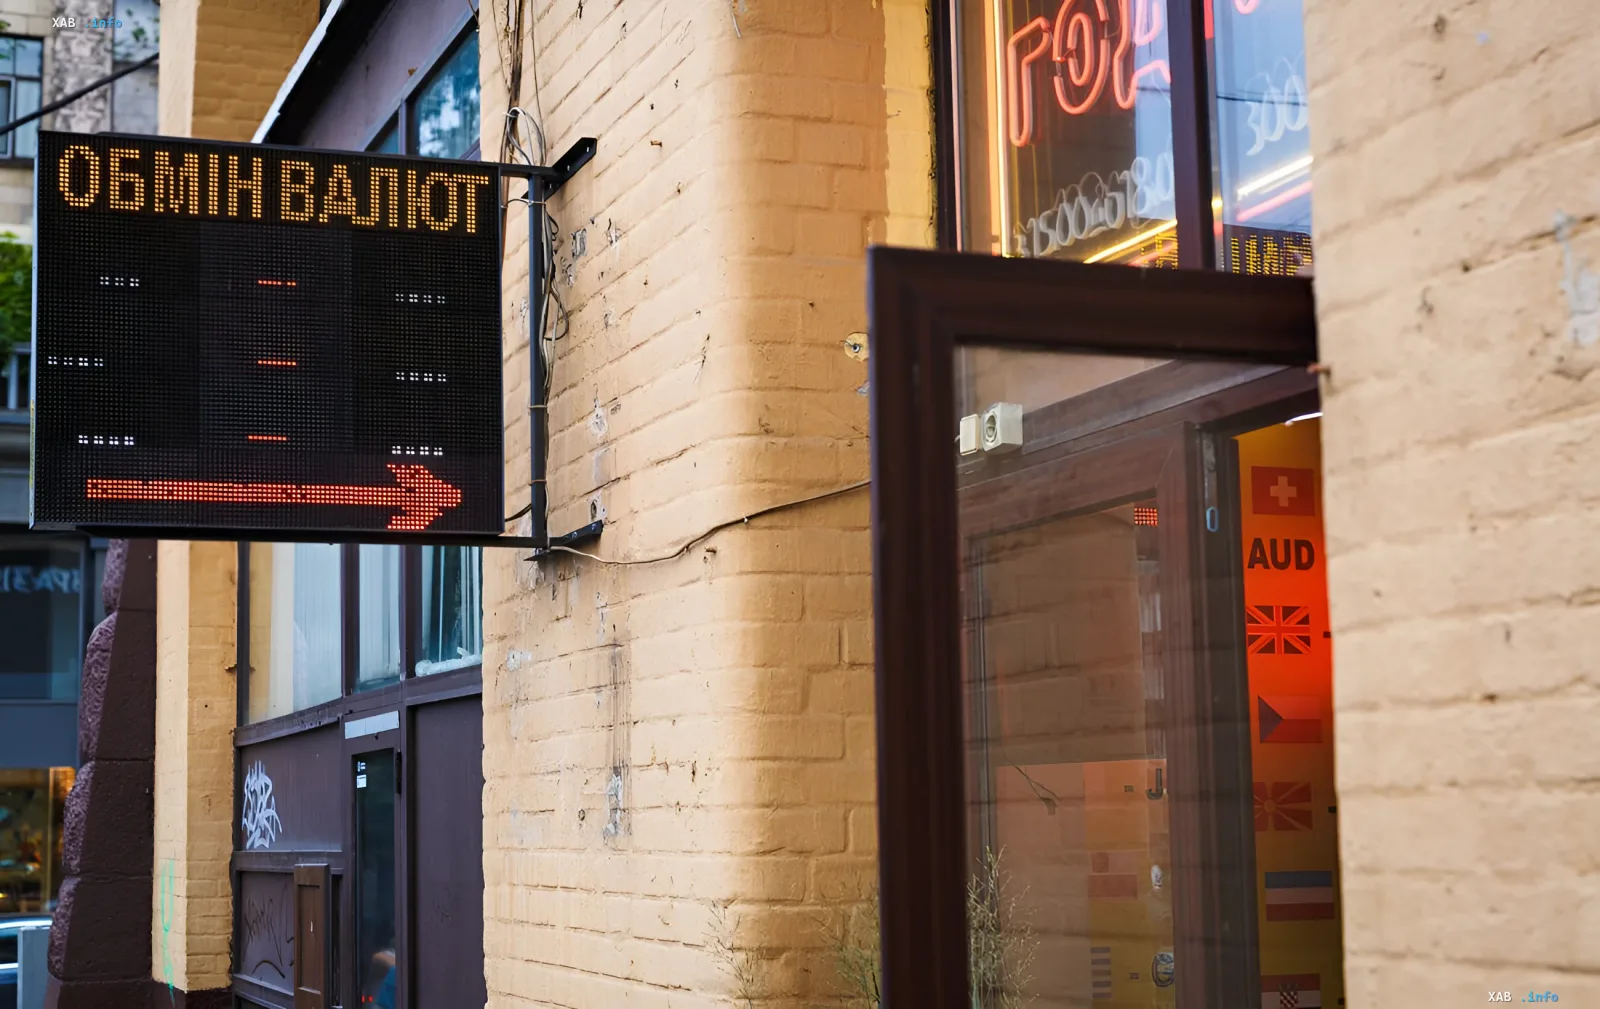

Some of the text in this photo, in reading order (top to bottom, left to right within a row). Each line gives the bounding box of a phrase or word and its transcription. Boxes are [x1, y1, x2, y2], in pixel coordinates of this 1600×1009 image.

[58, 144, 490, 234] ОБМІН ВАЛЮТ
[1247, 537, 1315, 571] AUD
